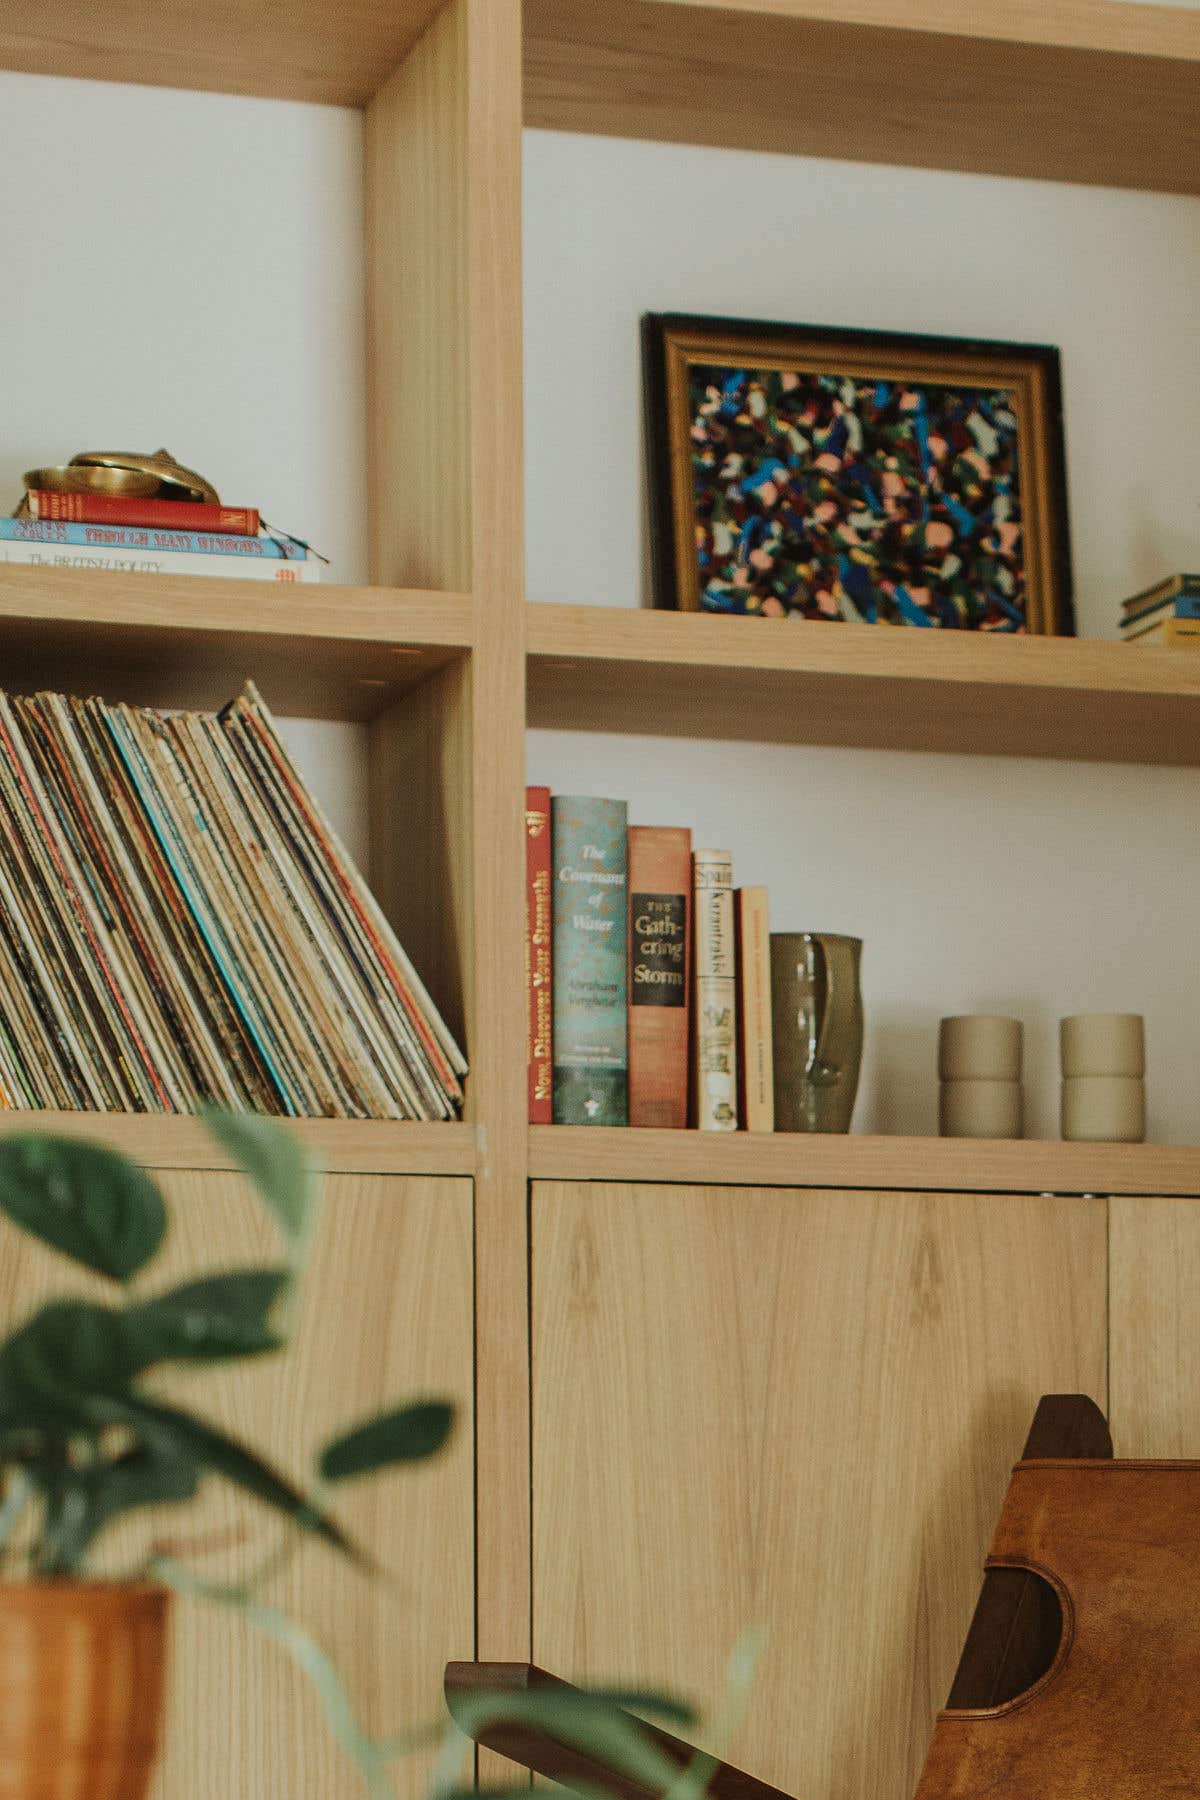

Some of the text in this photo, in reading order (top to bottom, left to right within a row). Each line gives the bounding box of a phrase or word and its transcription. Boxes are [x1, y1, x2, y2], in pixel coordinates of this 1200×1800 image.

[581, 844, 607, 859] The
[572, 914, 616, 931] Water
[532, 948, 551, 987] Your
[634, 963, 683, 986] Storm
